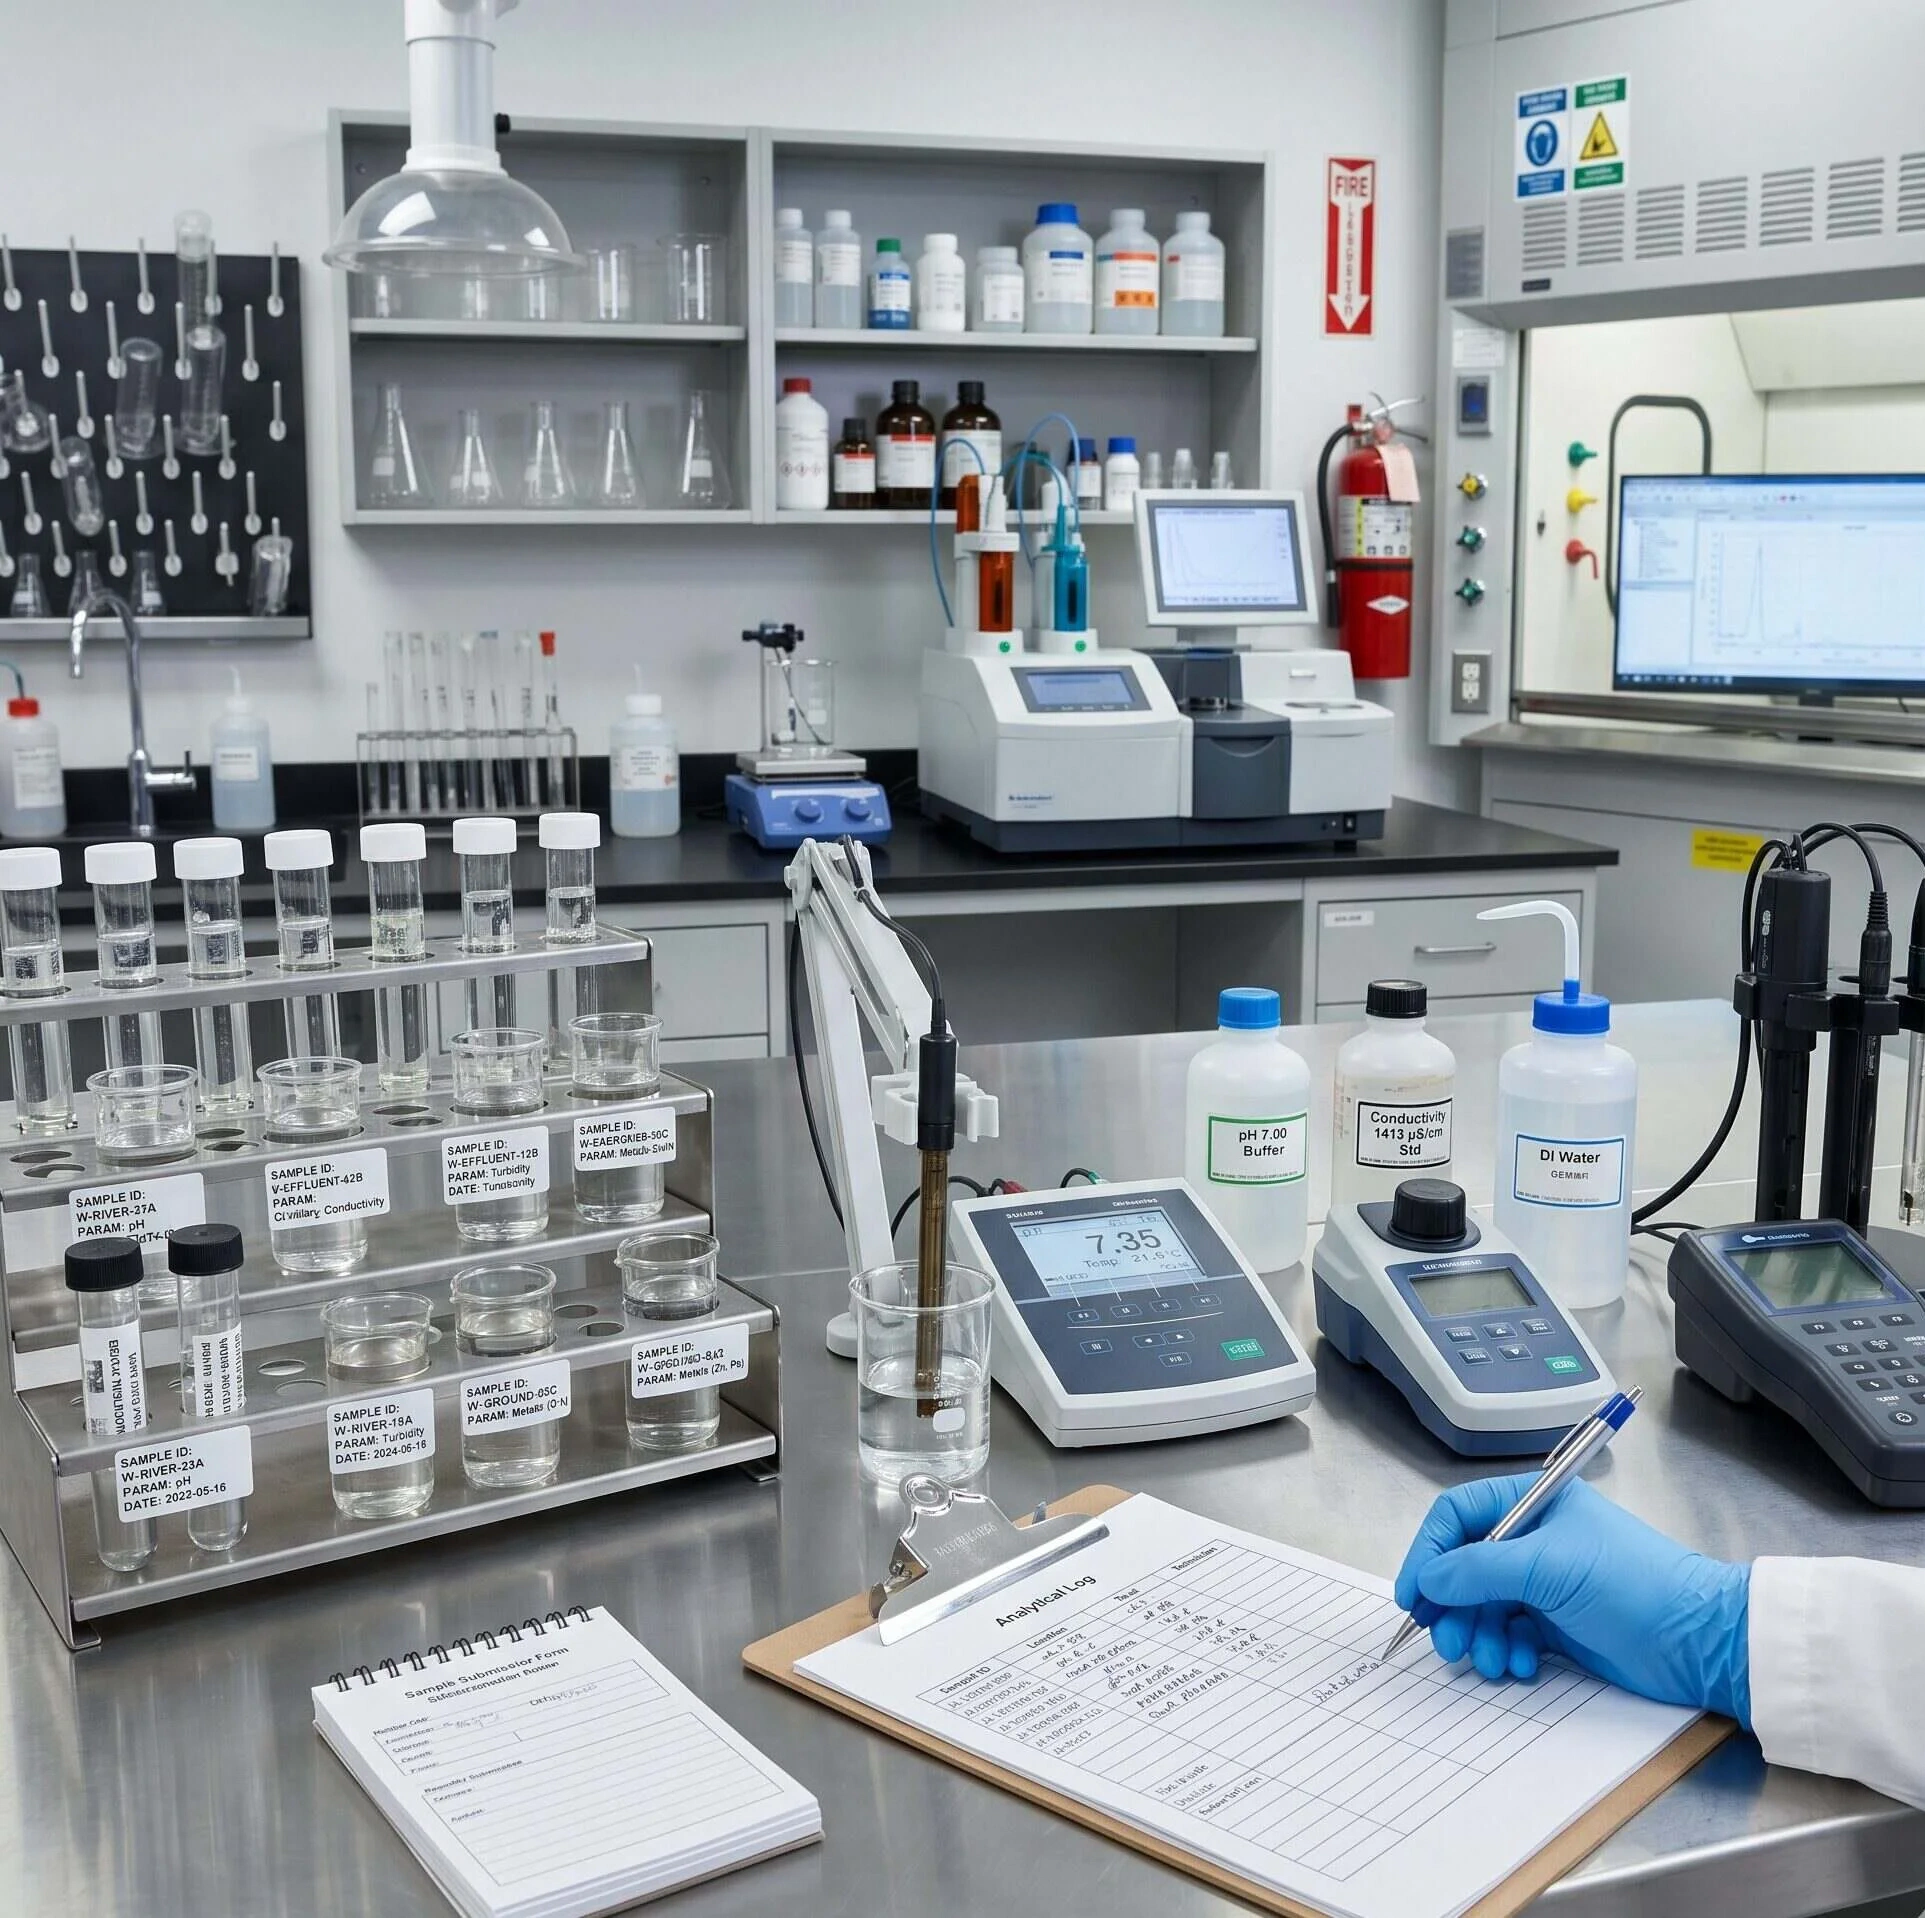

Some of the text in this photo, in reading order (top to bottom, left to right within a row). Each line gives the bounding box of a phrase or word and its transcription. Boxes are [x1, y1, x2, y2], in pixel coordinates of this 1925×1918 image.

[1336, 176, 1368, 197] FIRE
[1370, 1110, 1446, 1126] Conductivity
[580, 1121, 636, 1135] SAMPLE ID:
[1239, 1128, 1287, 1143] pH 7.00
[1374, 1127, 1404, 1141] 1413
[447, 1140, 508, 1156] SAMPLE ID:
[580, 1149, 617, 1161] PARAM:
[1243, 1145, 1285, 1157] Buffer
[1399, 1143, 1421, 1157] Std
[1540, 1149, 1600, 1163] DI Water
[448, 1148, 539, 1169] W-EFFLUENT-12B
[271, 1163, 335, 1180] SAMPLE ID:
[448, 1164, 530, 1183] PARAM: Turbidity
[449, 1184, 480, 1196] DATE:
[76, 1190, 146, 1208] SAMPLE ID:
[273, 1194, 317, 1208] PARAM:
[324, 1197, 385, 1215] Conductivity
[78, 1222, 125, 1237] PARAM:
[129, 1219, 145, 1232] pH
[1085, 1228, 1162, 1255] 7.35
[637, 1342, 694, 1360] SAMPLE ID:
[467, 1378, 528, 1397] SAMPLE ID:
[637, 1373, 676, 1386] PARAM:
[334, 1404, 400, 1422] SAMPLE ID:
[468, 1411, 509, 1425] PARAM:
[335, 1436, 379, 1450] PARAM:
[120, 1446, 192, 1468] SAMPLE ID:
[336, 1451, 370, 1465] DATE:
[122, 1458, 204, 1482] W-RIVER-23A
[123, 1476, 191, 1497] PARAM: pH
[124, 1482, 226, 1512] DATE: 2022-05-16
[996, 1575, 1097, 1627] Analytical Log
[534, 1647, 569, 1661] Form
